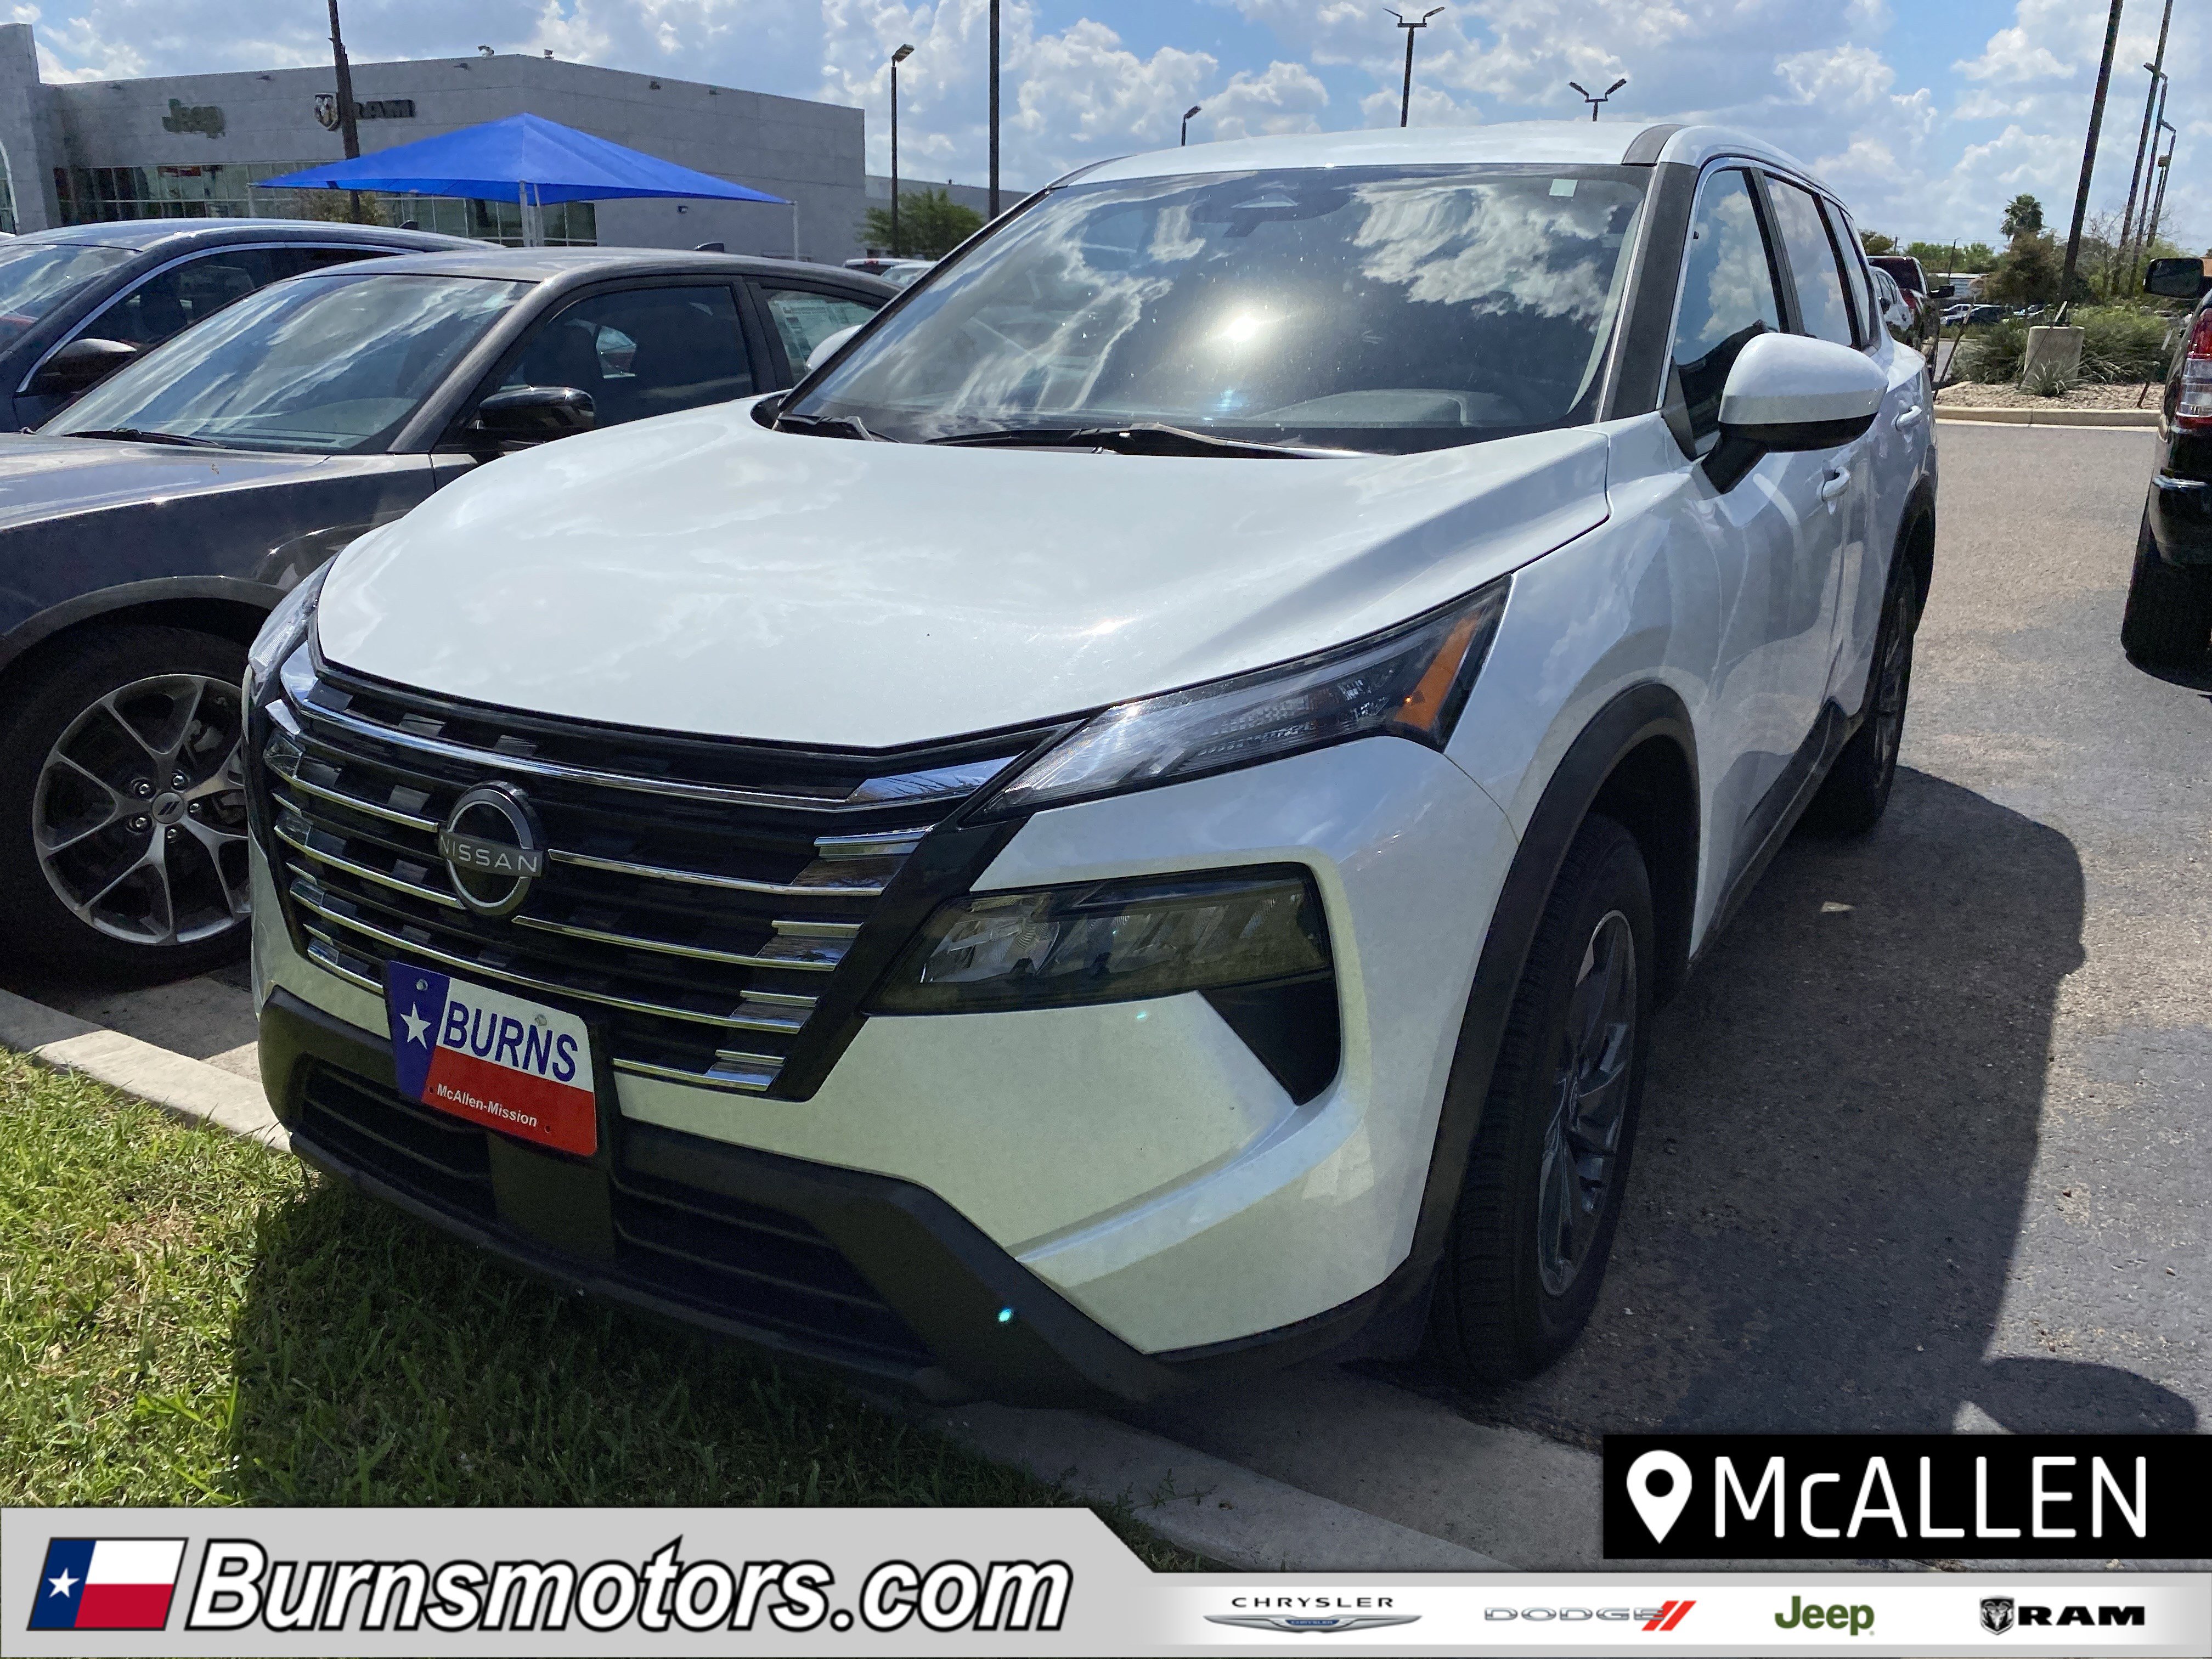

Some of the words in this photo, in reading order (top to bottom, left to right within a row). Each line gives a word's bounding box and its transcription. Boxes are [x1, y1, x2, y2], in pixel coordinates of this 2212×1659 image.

[440, 834, 537, 872] NISSAN
[443, 1001, 578, 1082] BURNS
[437, 1083, 538, 1128] McAllen-Mission
